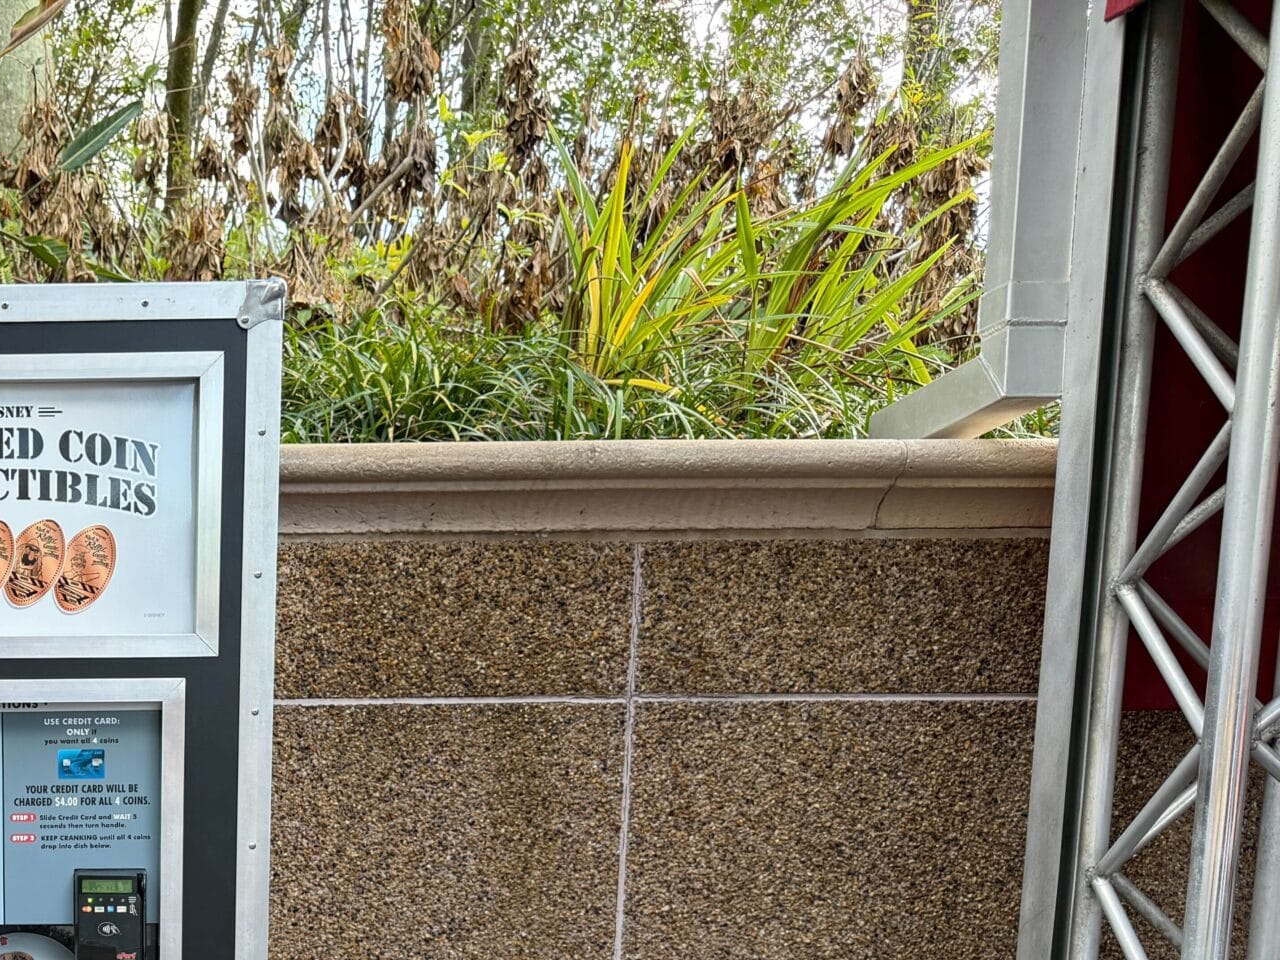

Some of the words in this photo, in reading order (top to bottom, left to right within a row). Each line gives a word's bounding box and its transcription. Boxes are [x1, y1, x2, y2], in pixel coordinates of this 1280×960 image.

[59, 430, 159, 476] COIN
[25, 785, 48, 794] YOUR
[51, 785, 78, 794] CREDIT
[82, 784, 103, 793] CARD
[106, 784, 125, 793] WILL
[129, 784, 138, 793] BE
[14, 798, 52, 807] CHARGED
[55, 797, 77, 807] $4.00
[80, 797, 96, 806] FOR
[99, 797, 112, 806] ALL
[115, 797, 120, 805] 4
[123, 796, 150, 805] COINS.
